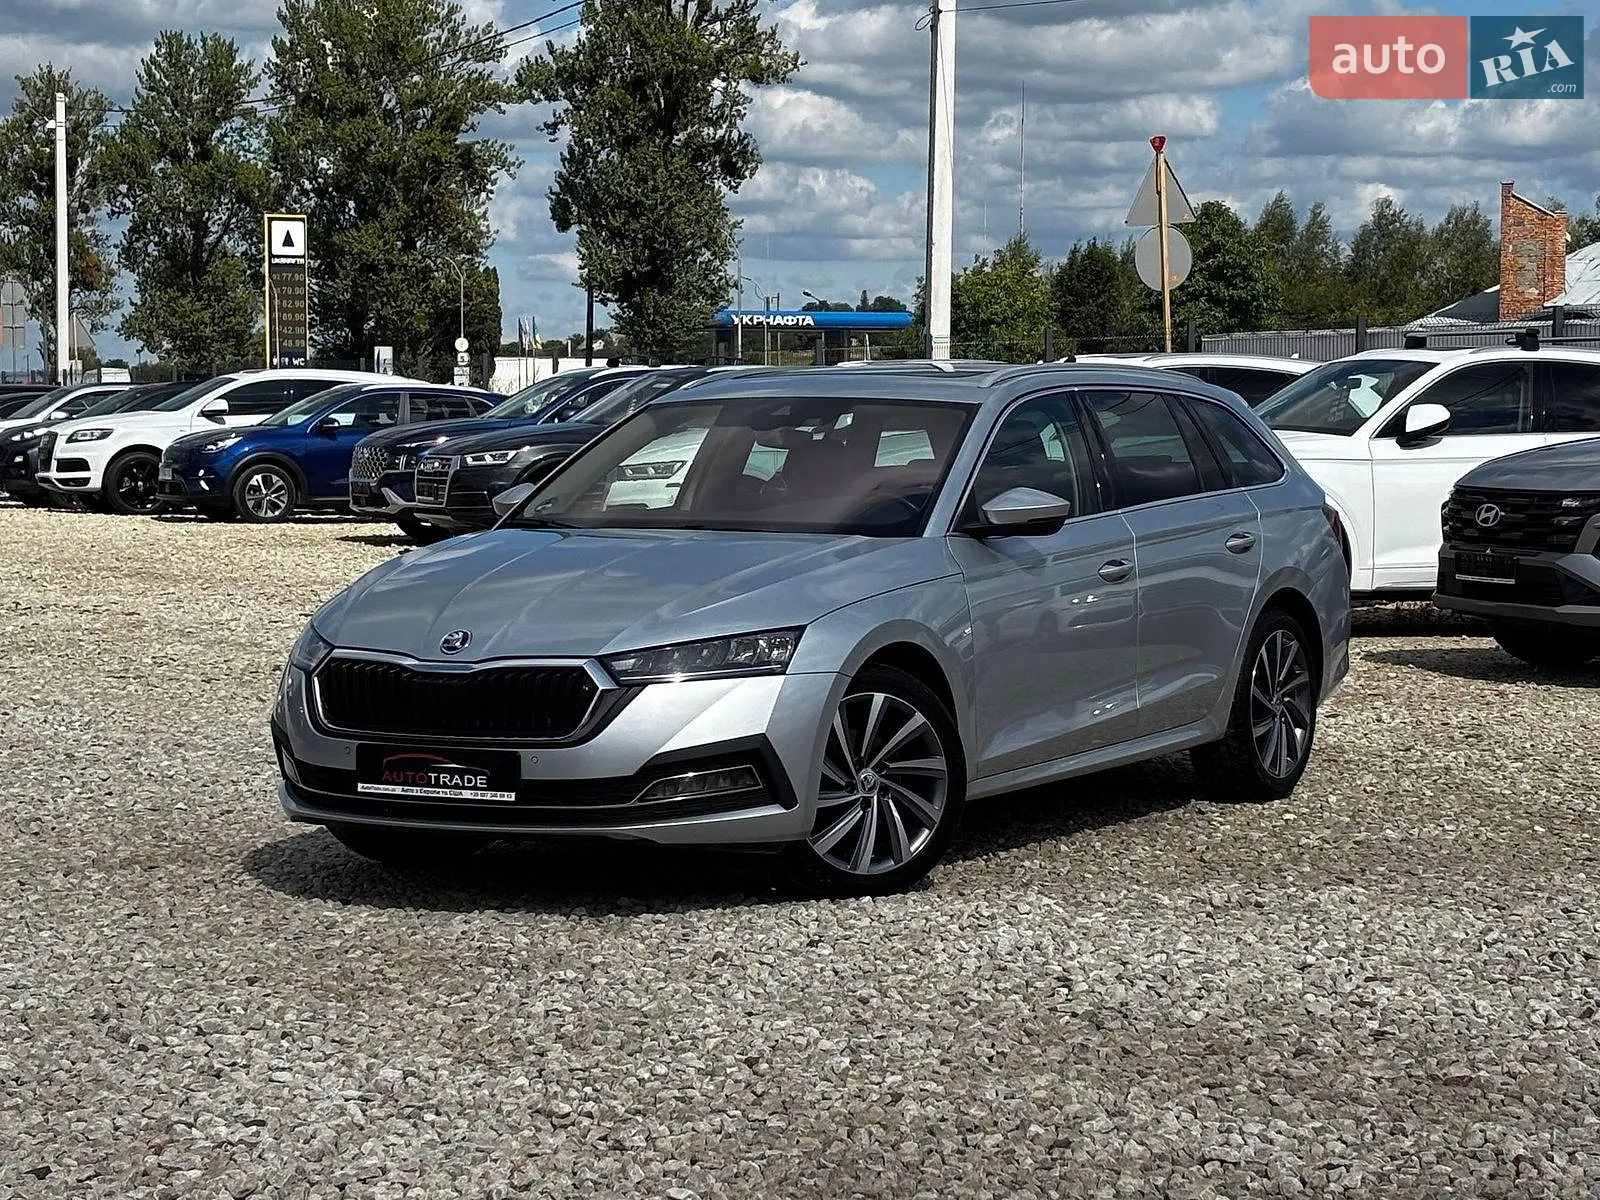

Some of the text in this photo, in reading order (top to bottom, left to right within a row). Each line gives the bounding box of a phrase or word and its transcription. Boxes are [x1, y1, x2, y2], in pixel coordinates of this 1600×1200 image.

[730, 314, 815, 326] УКРНАФТА
[292, 357, 305, 366] WC
[382, 770, 488, 788] AUTOTRADE
